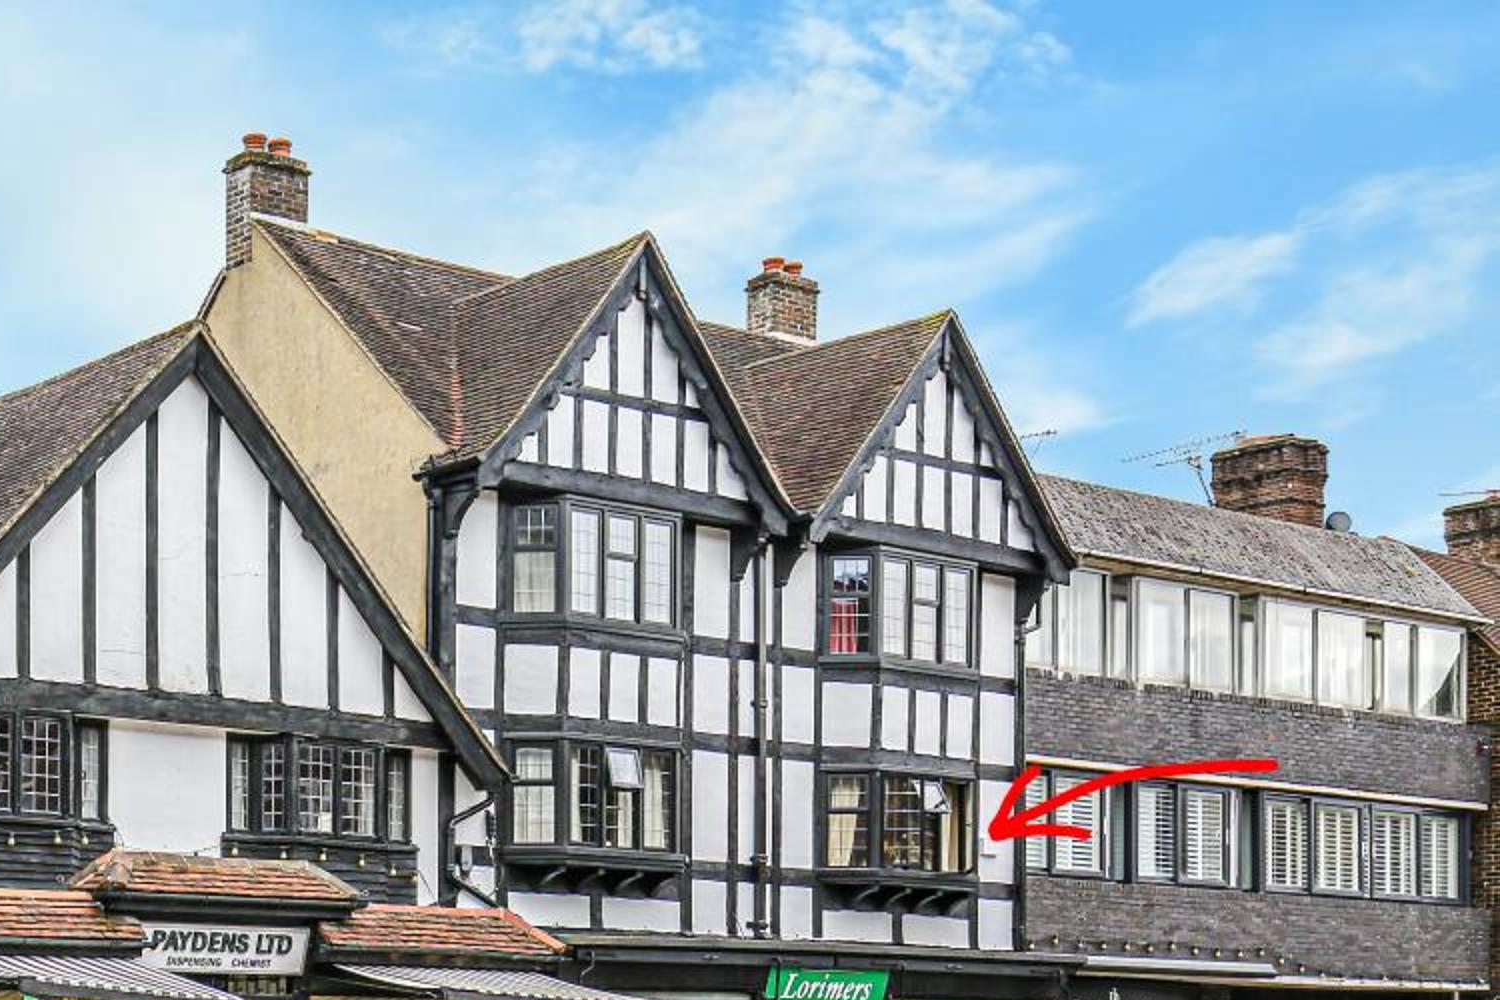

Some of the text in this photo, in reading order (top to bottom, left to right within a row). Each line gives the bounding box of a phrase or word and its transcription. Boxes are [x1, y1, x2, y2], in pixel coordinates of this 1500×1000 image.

[152, 930, 293, 955] PAYDENS LTD
[780, 972, 873, 1000] Lorimers
